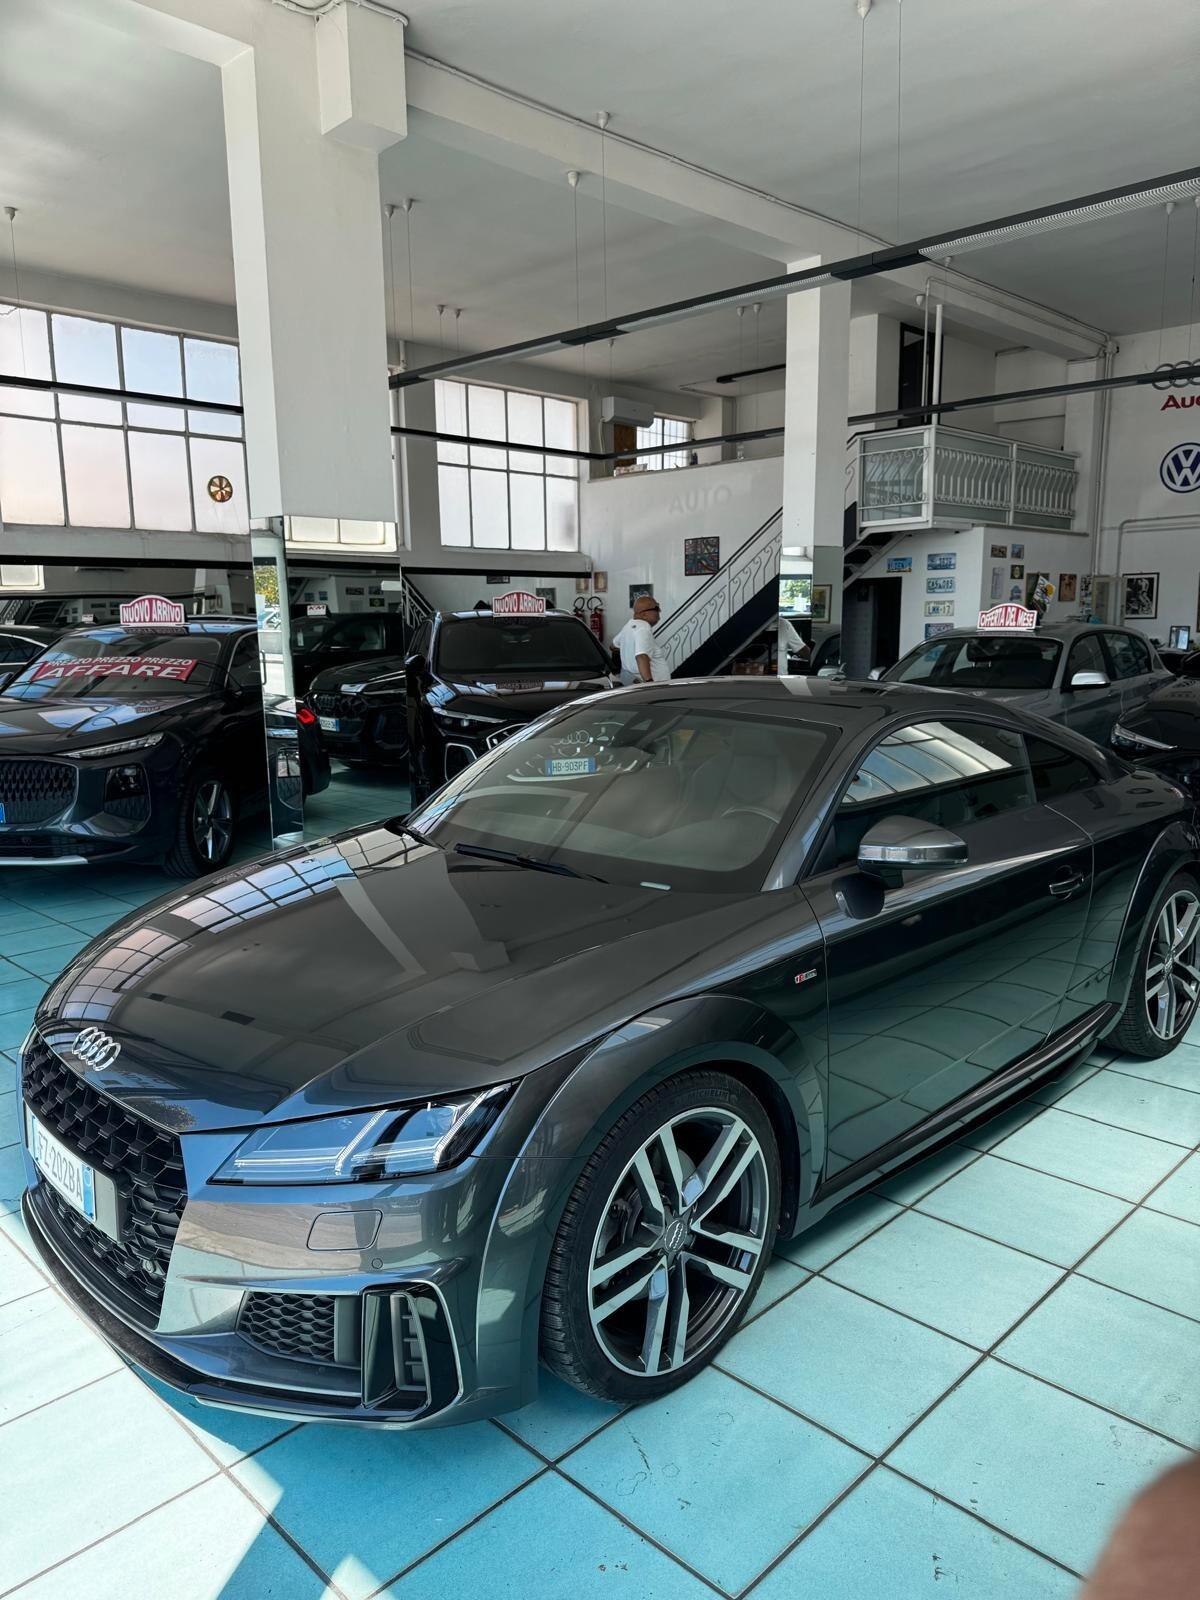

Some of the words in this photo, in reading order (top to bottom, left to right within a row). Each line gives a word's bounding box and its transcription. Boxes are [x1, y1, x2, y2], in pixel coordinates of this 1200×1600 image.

[667, 484, 733, 514] AUTO
[122, 599, 150, 622] NUOVO
[152, 599, 181, 622] ARRIVO
[494, 593, 518, 612] NUOVO
[519, 593, 544, 612] ARRIVO
[980, 607, 1005, 627] OFFERTA
[1005, 606, 1018, 627] DEL
[1017, 608, 1035, 627] MESE
[48, 657, 90, 666] PREZZO
[92, 656, 141, 664] PREZZO
[142, 656, 193, 666] PREZZO
[39, 664, 186, 679] AFFARE
